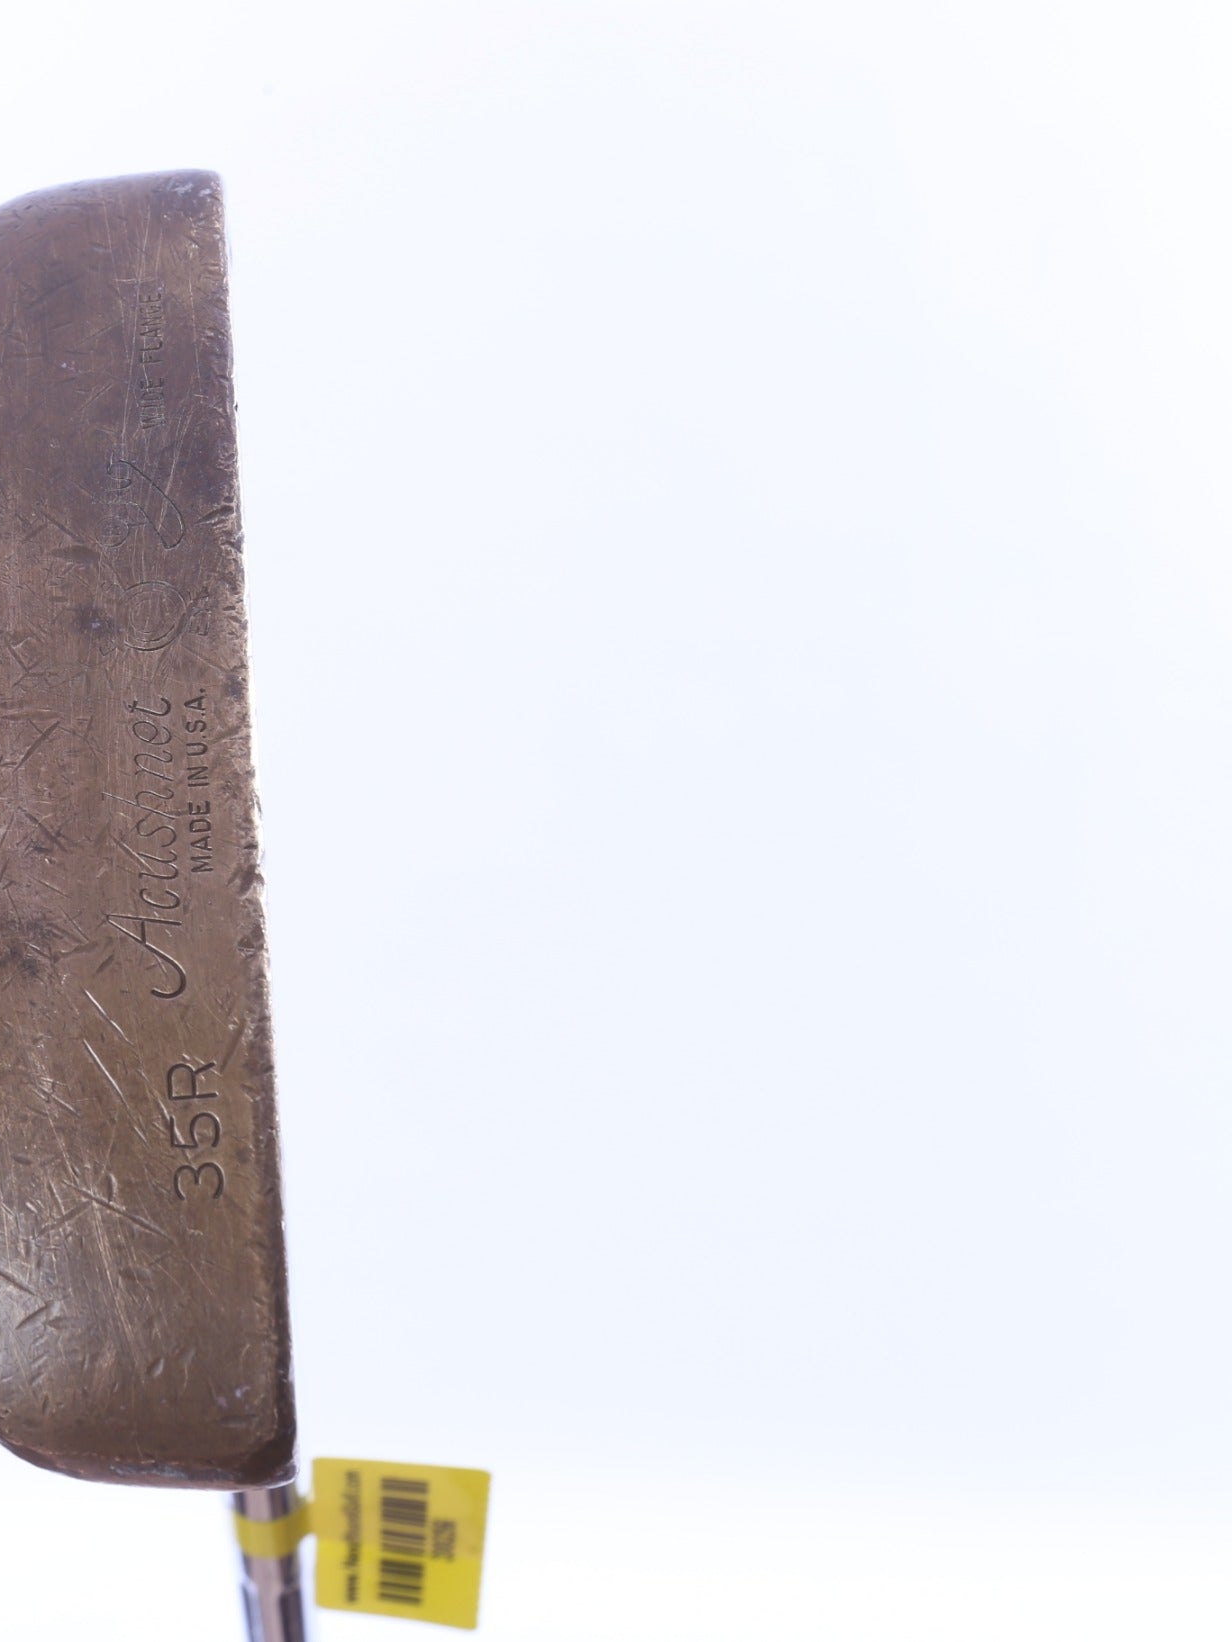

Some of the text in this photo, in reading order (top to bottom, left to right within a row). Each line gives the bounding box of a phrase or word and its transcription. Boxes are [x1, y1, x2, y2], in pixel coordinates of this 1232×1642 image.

[138, 292, 166, 430] WIDE FLANGE
[102, 696, 187, 999] Acushnet
[184, 687, 214, 874] MADE IN U.S.A.
[167, 1060, 225, 1201] 35R
